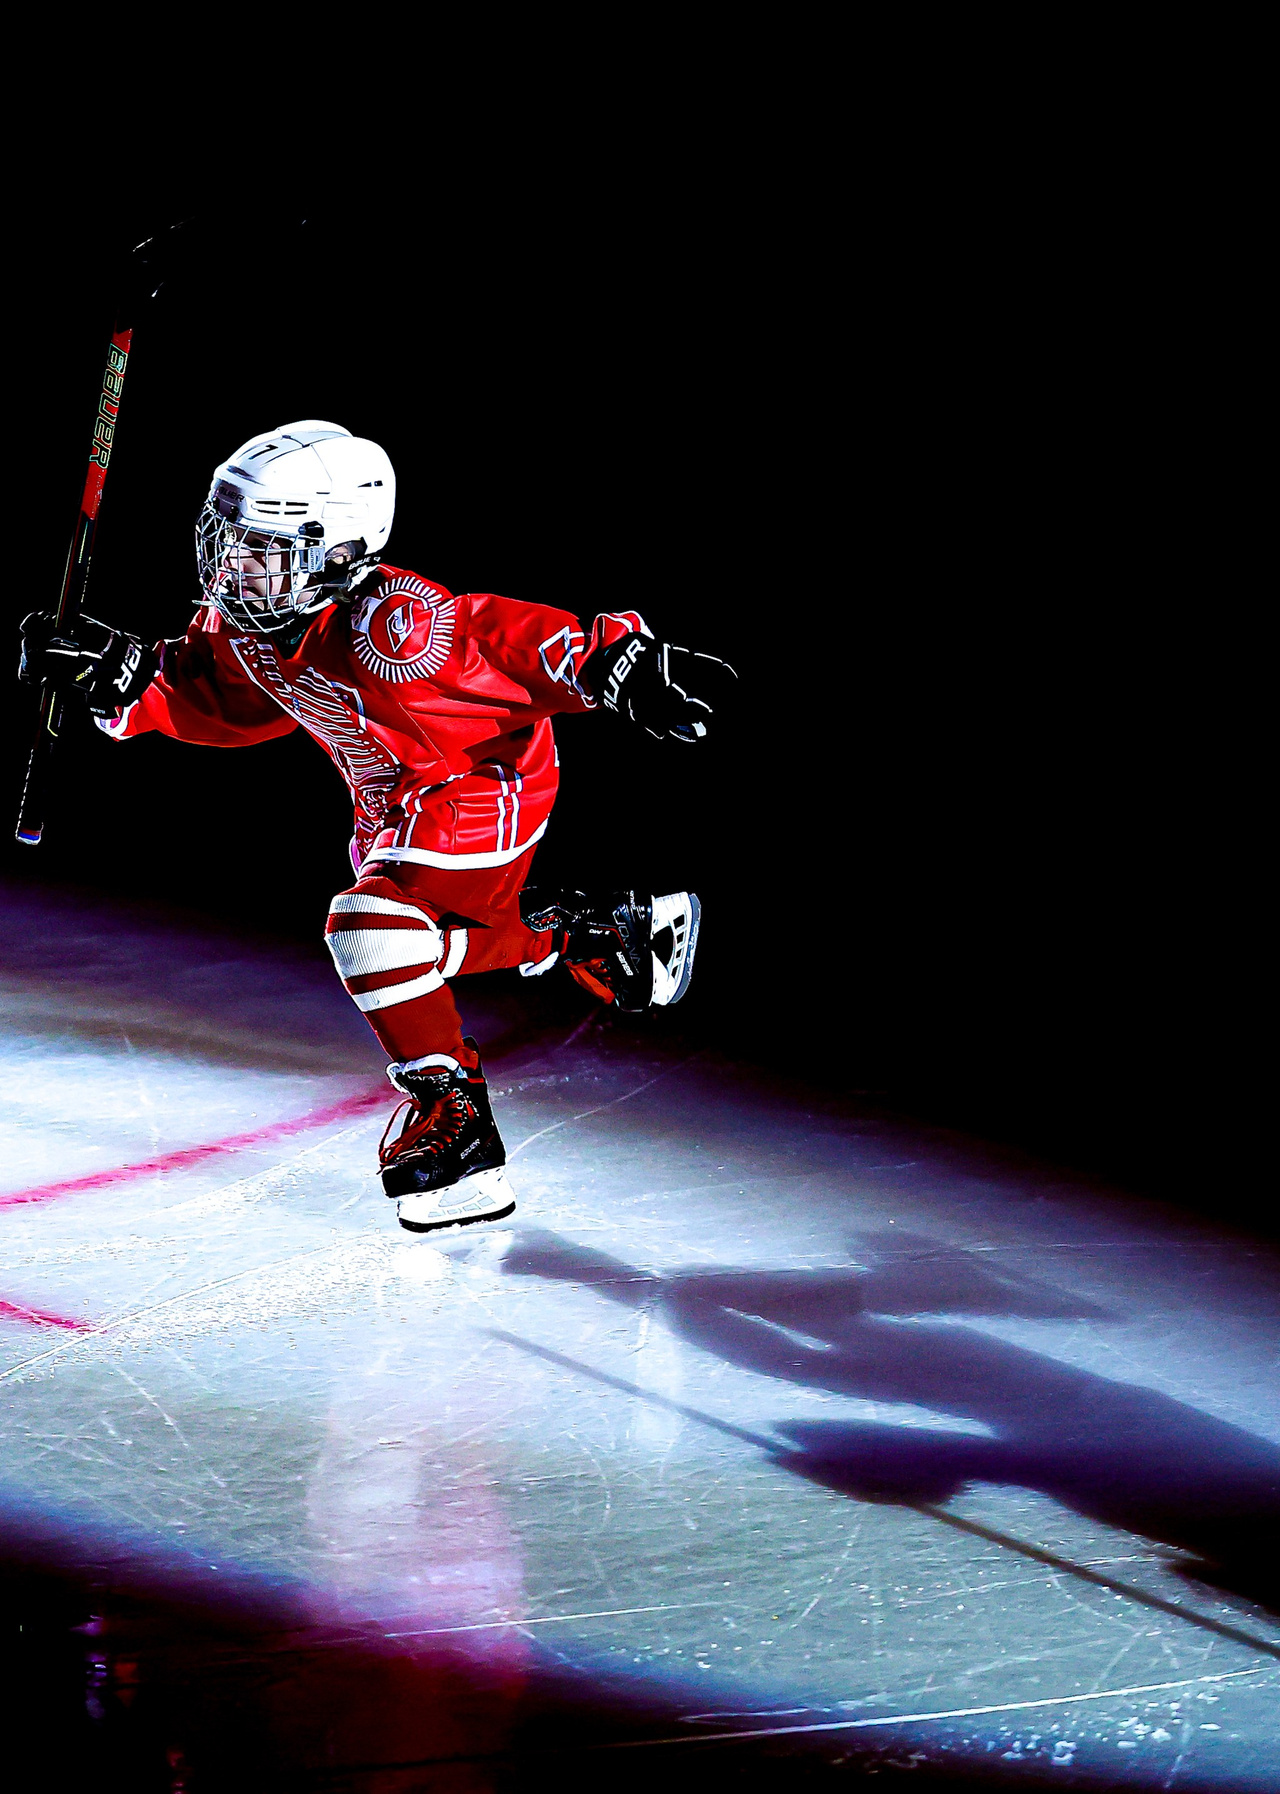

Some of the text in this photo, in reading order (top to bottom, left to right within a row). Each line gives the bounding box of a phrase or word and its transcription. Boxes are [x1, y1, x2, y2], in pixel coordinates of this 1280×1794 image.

[88, 342, 128, 469] BAUER
[219, 486, 245, 502] AUER
[112, 640, 142, 693] ER
[616, 951, 634, 976] BAUER
